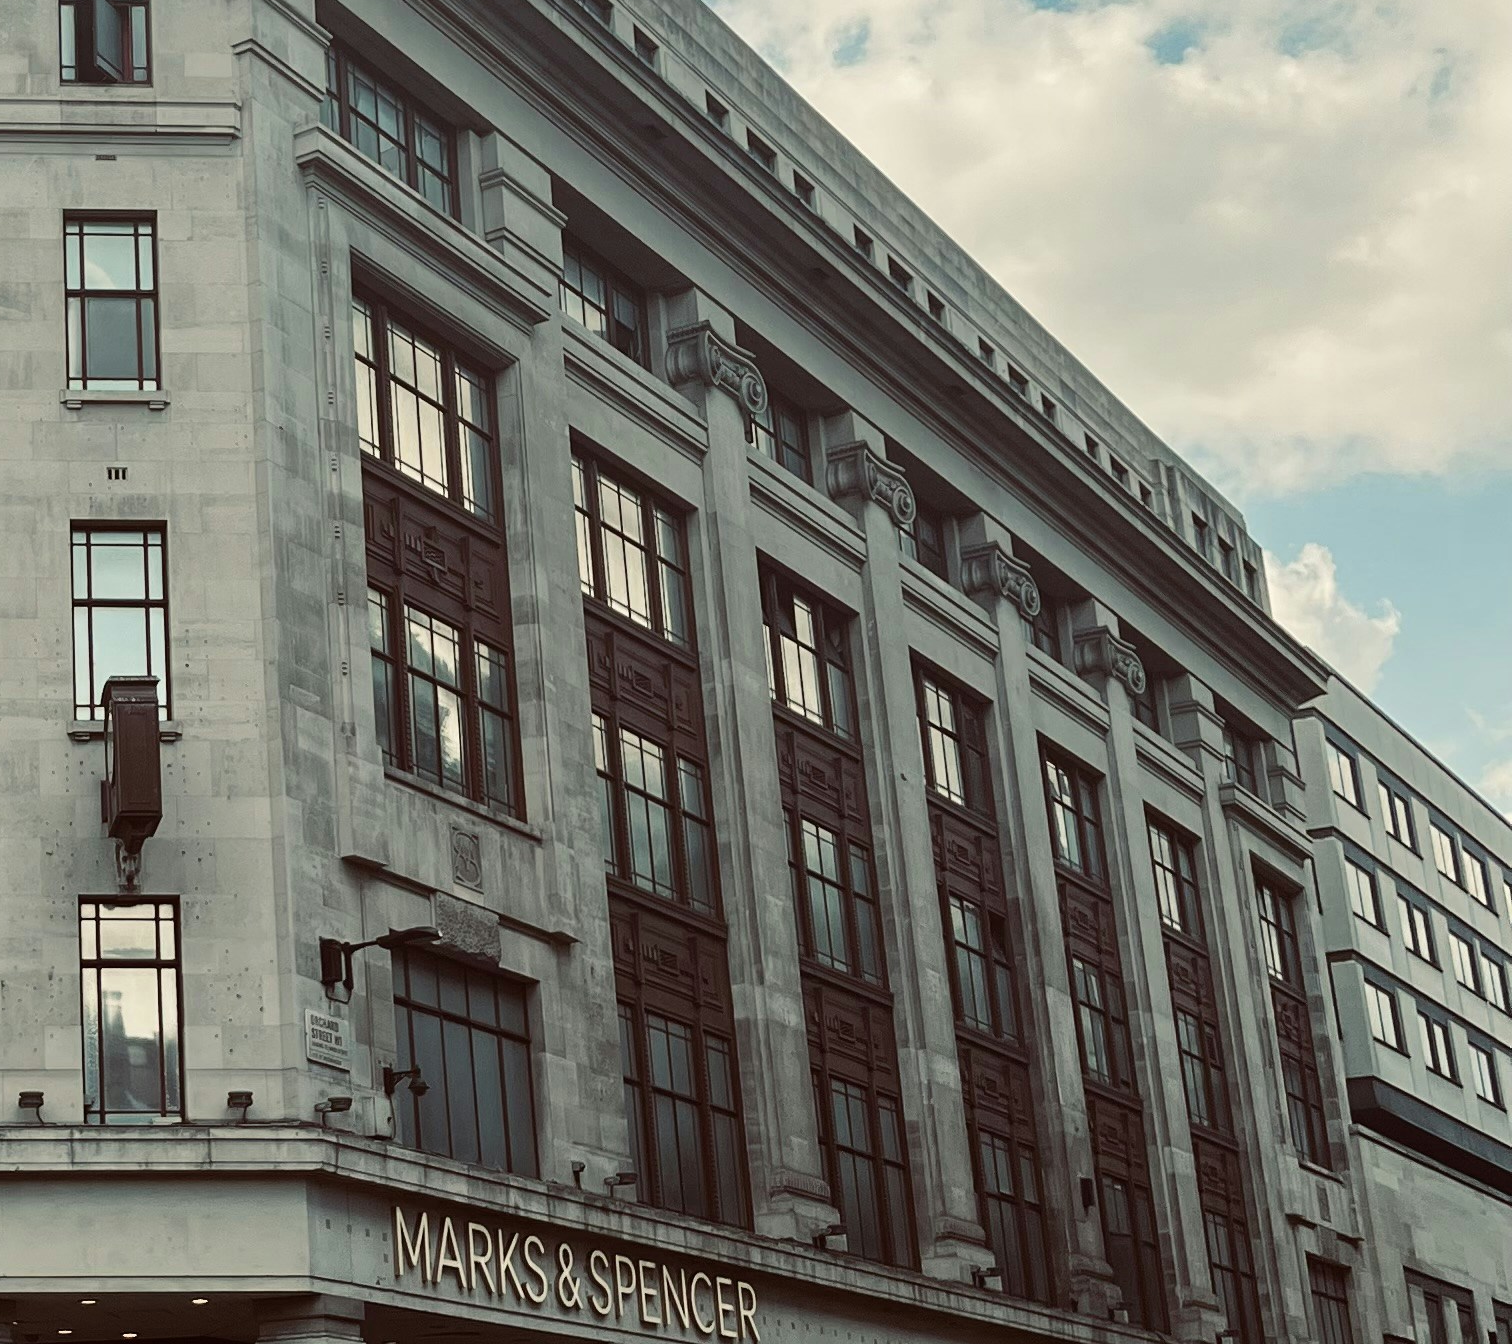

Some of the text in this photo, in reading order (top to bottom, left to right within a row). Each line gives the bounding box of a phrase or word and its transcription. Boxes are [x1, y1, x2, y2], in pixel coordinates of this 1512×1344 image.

[393, 1206, 762, 1344] MARKS & SPENCER
